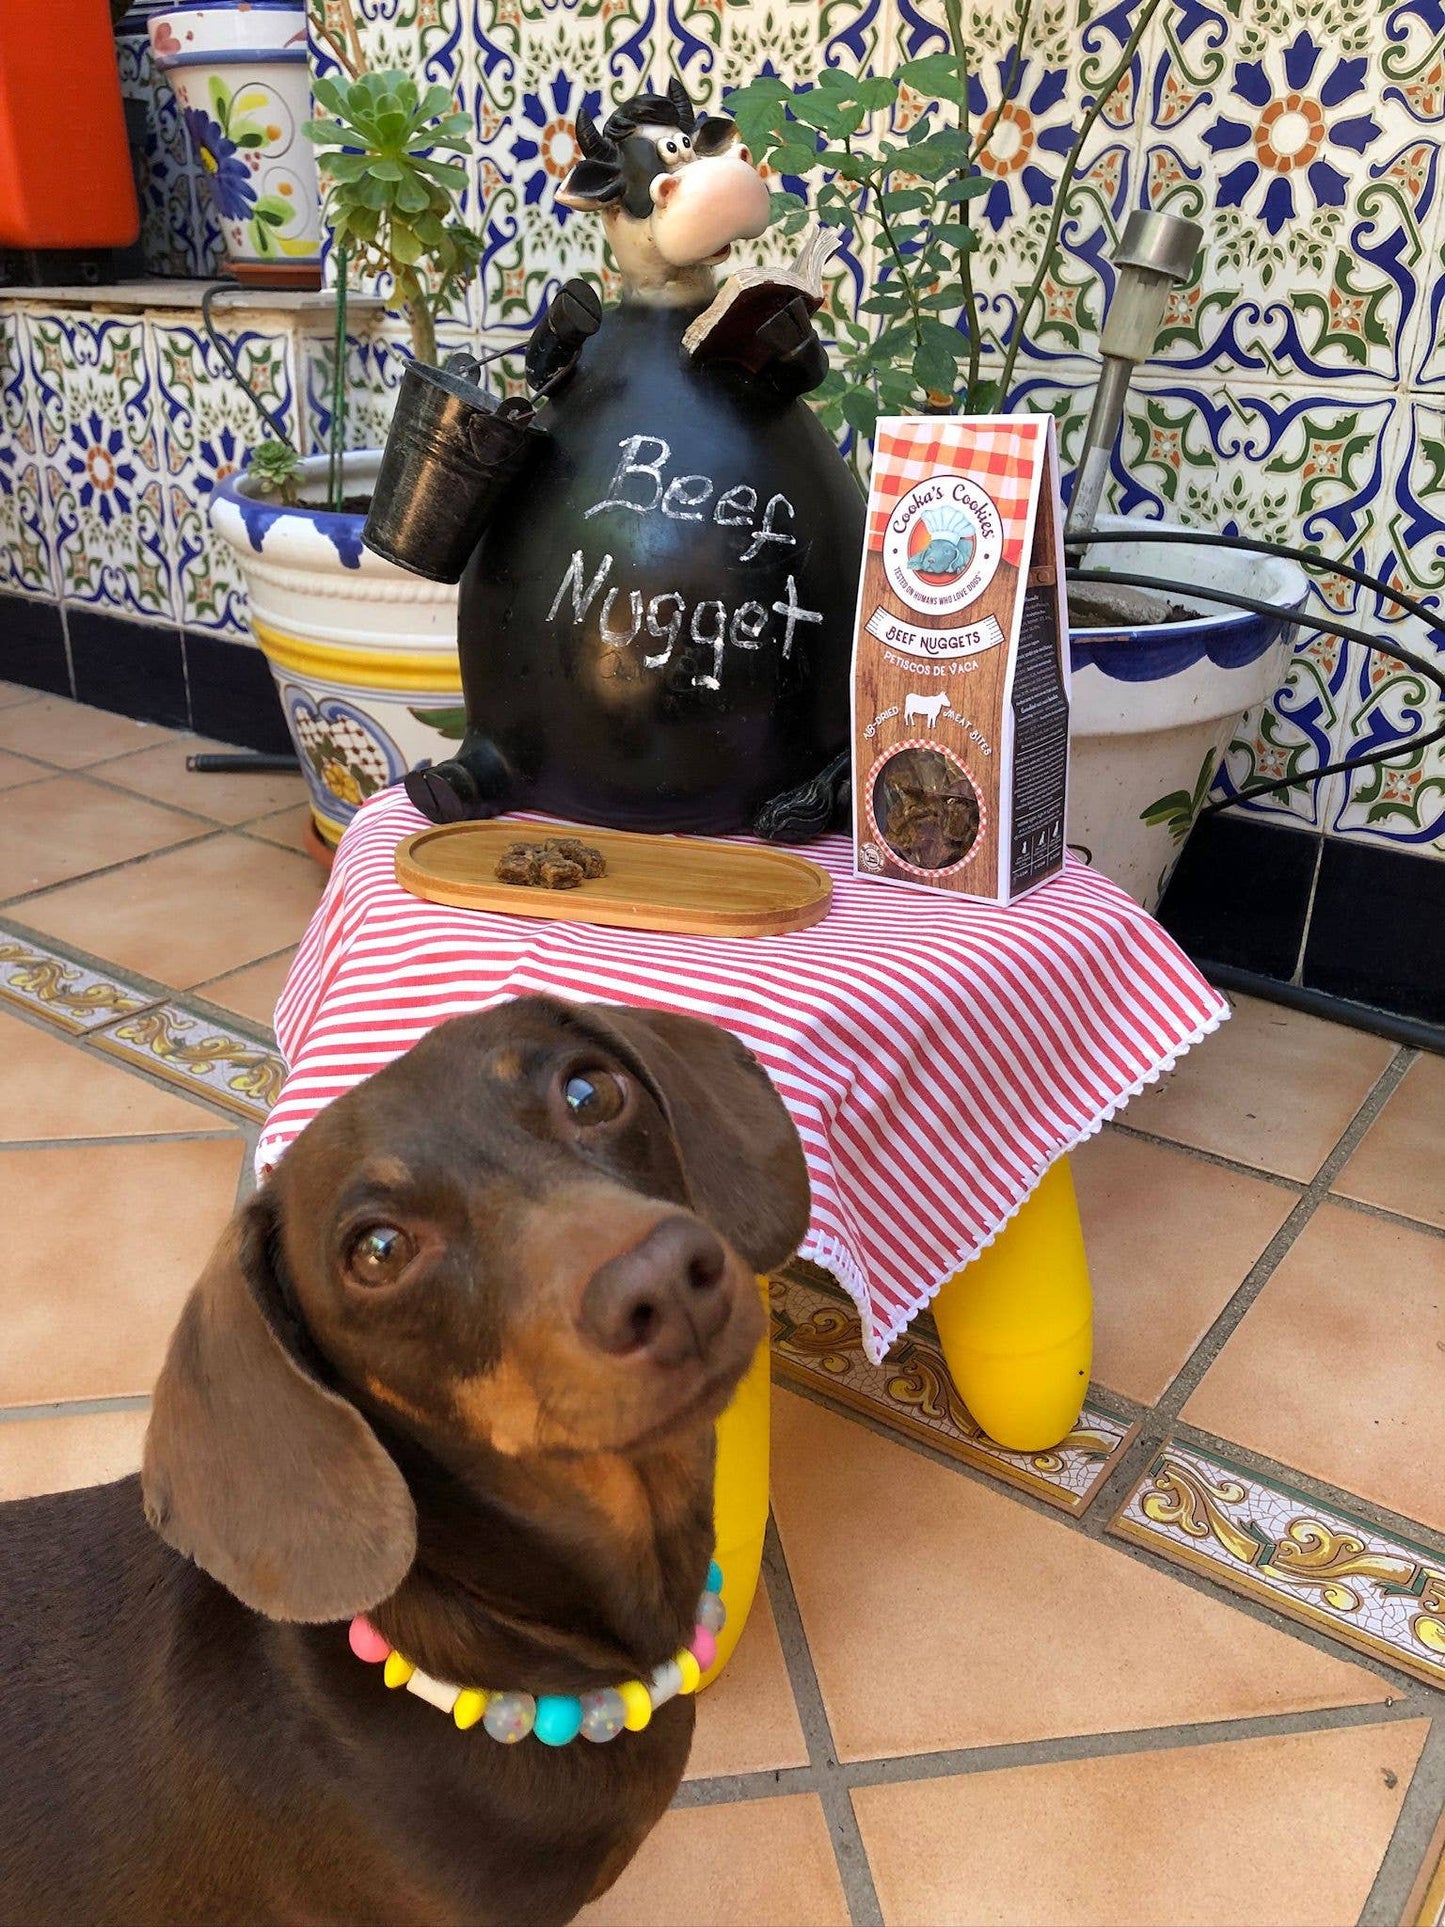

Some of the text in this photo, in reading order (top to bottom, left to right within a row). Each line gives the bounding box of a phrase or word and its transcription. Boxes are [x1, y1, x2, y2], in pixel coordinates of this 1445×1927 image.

[584, 434, 796, 562] Beef
[893, 484, 993, 539] Cooka's Cookies
[894, 566, 908, 589] TESTED
[905, 586, 915, 597] ON
[914, 591, 938, 605] HUMANS
[953, 588, 970, 600] LOVE
[968, 575, 981, 592] DOGS
[545, 550, 823, 690] Nugget
[885, 626, 981, 654] BEEF NUGGETS
[884, 651, 979, 676] PETISCOS DE VACA
[863, 706, 991, 756] AIR-DRIED MEAT BITES
